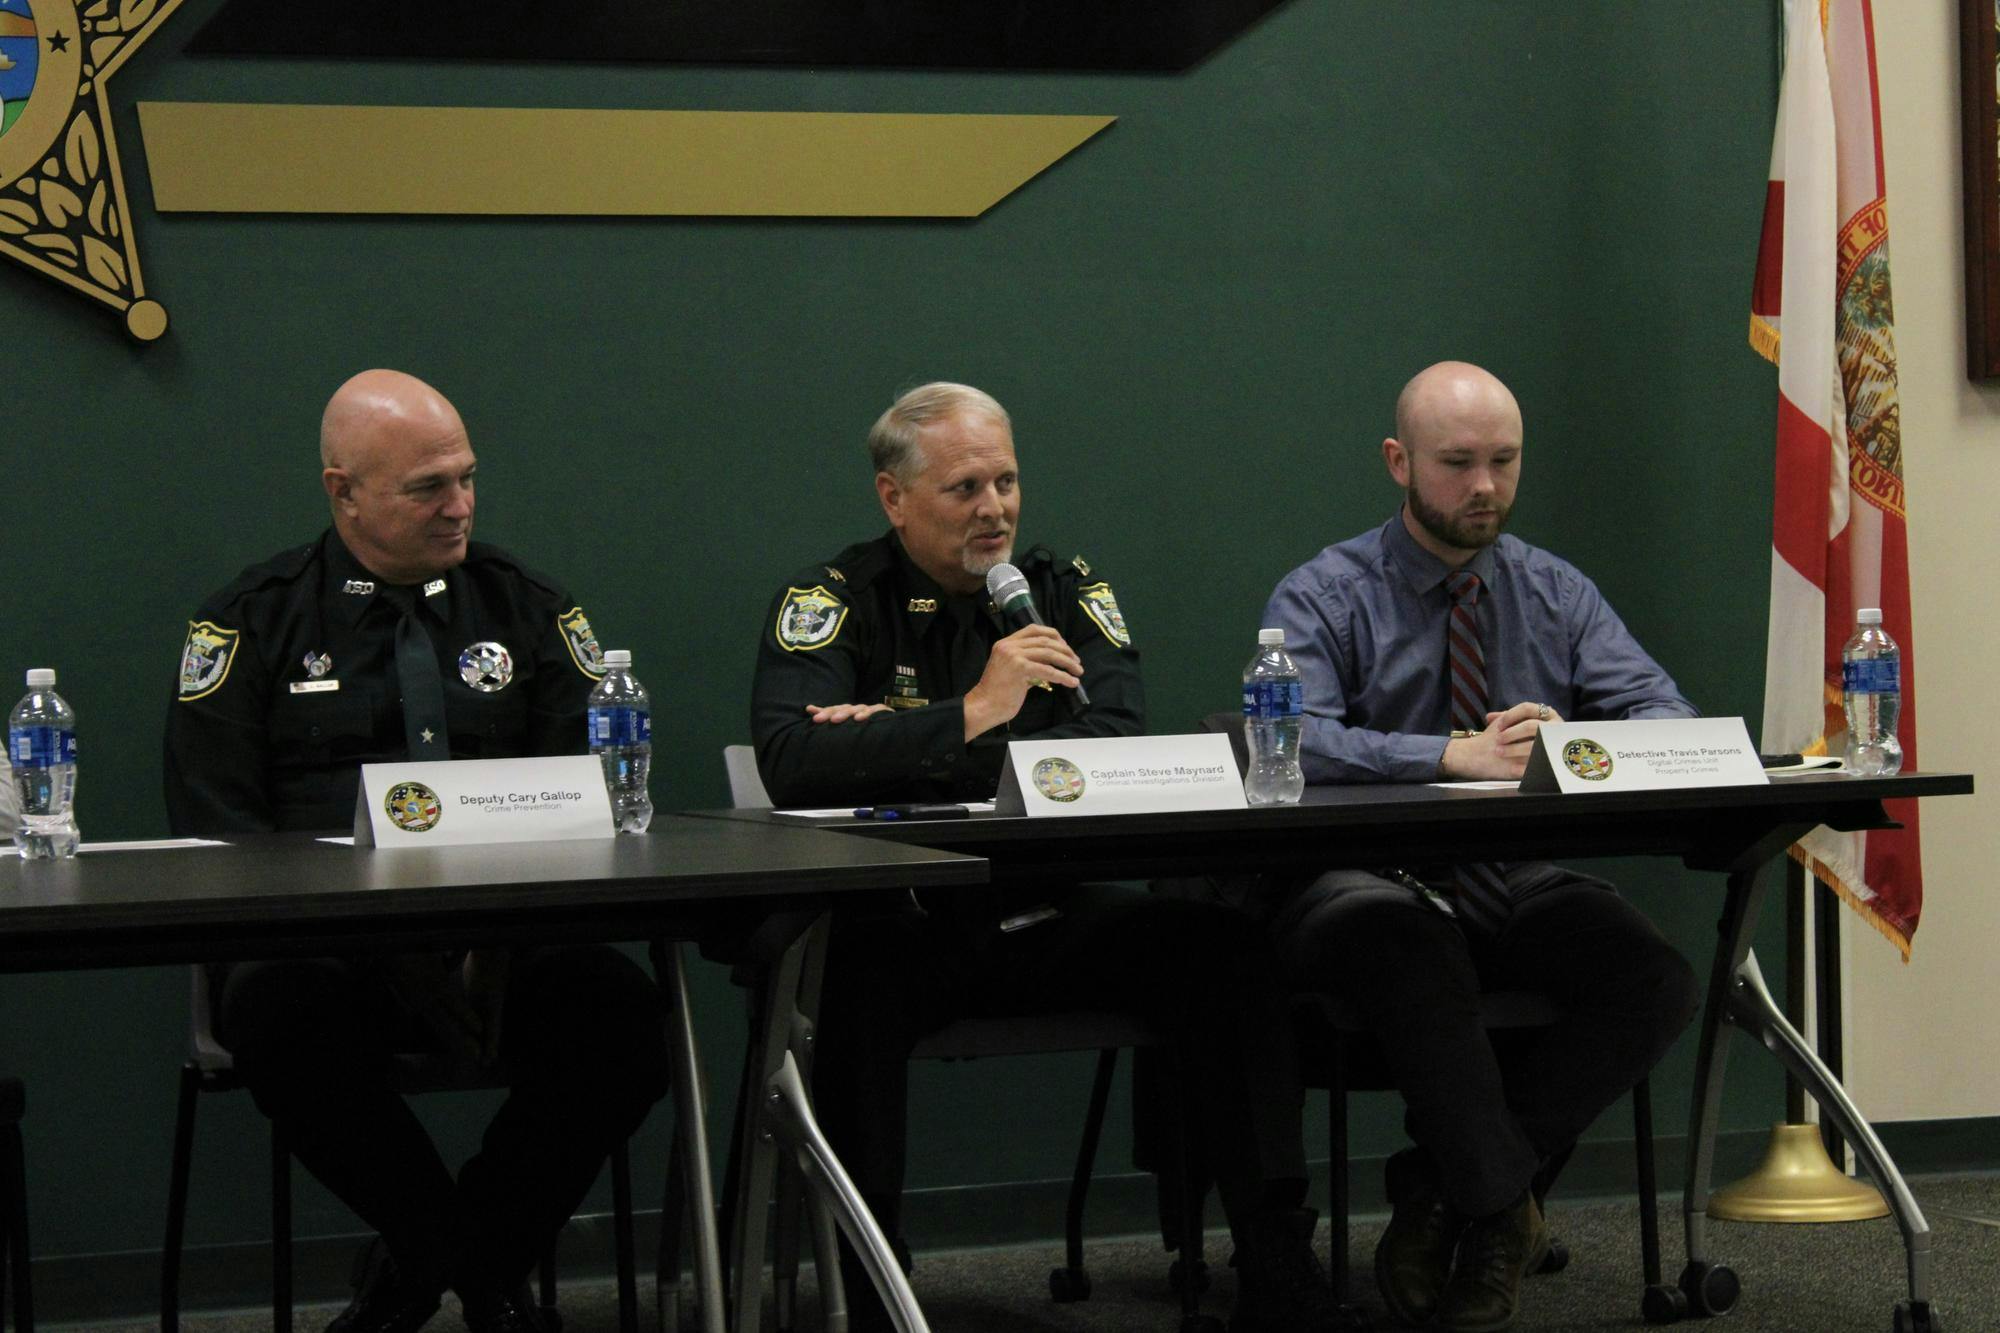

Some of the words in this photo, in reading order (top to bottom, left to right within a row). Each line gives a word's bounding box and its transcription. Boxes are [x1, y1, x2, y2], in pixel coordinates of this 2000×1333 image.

[1616, 750, 1666, 759] Detective
[1667, 748, 1699, 757] Travis
[1700, 748, 1742, 757] Parsons
[1090, 768, 1136, 779] Captain
[1137, 767, 1171, 777] Steve
[1174, 765, 1225, 776] Maynard
[1095, 778, 1131, 788] Criminal
[1132, 777, 1191, 786] Investigations
[1192, 774, 1225, 784] Division
[460, 793, 504, 806] Deputy
[508, 792, 537, 803] Cary
[540, 790, 582, 802] Gallop
[484, 804, 512, 814] Crime
[513, 802, 562, 812] Prevention
